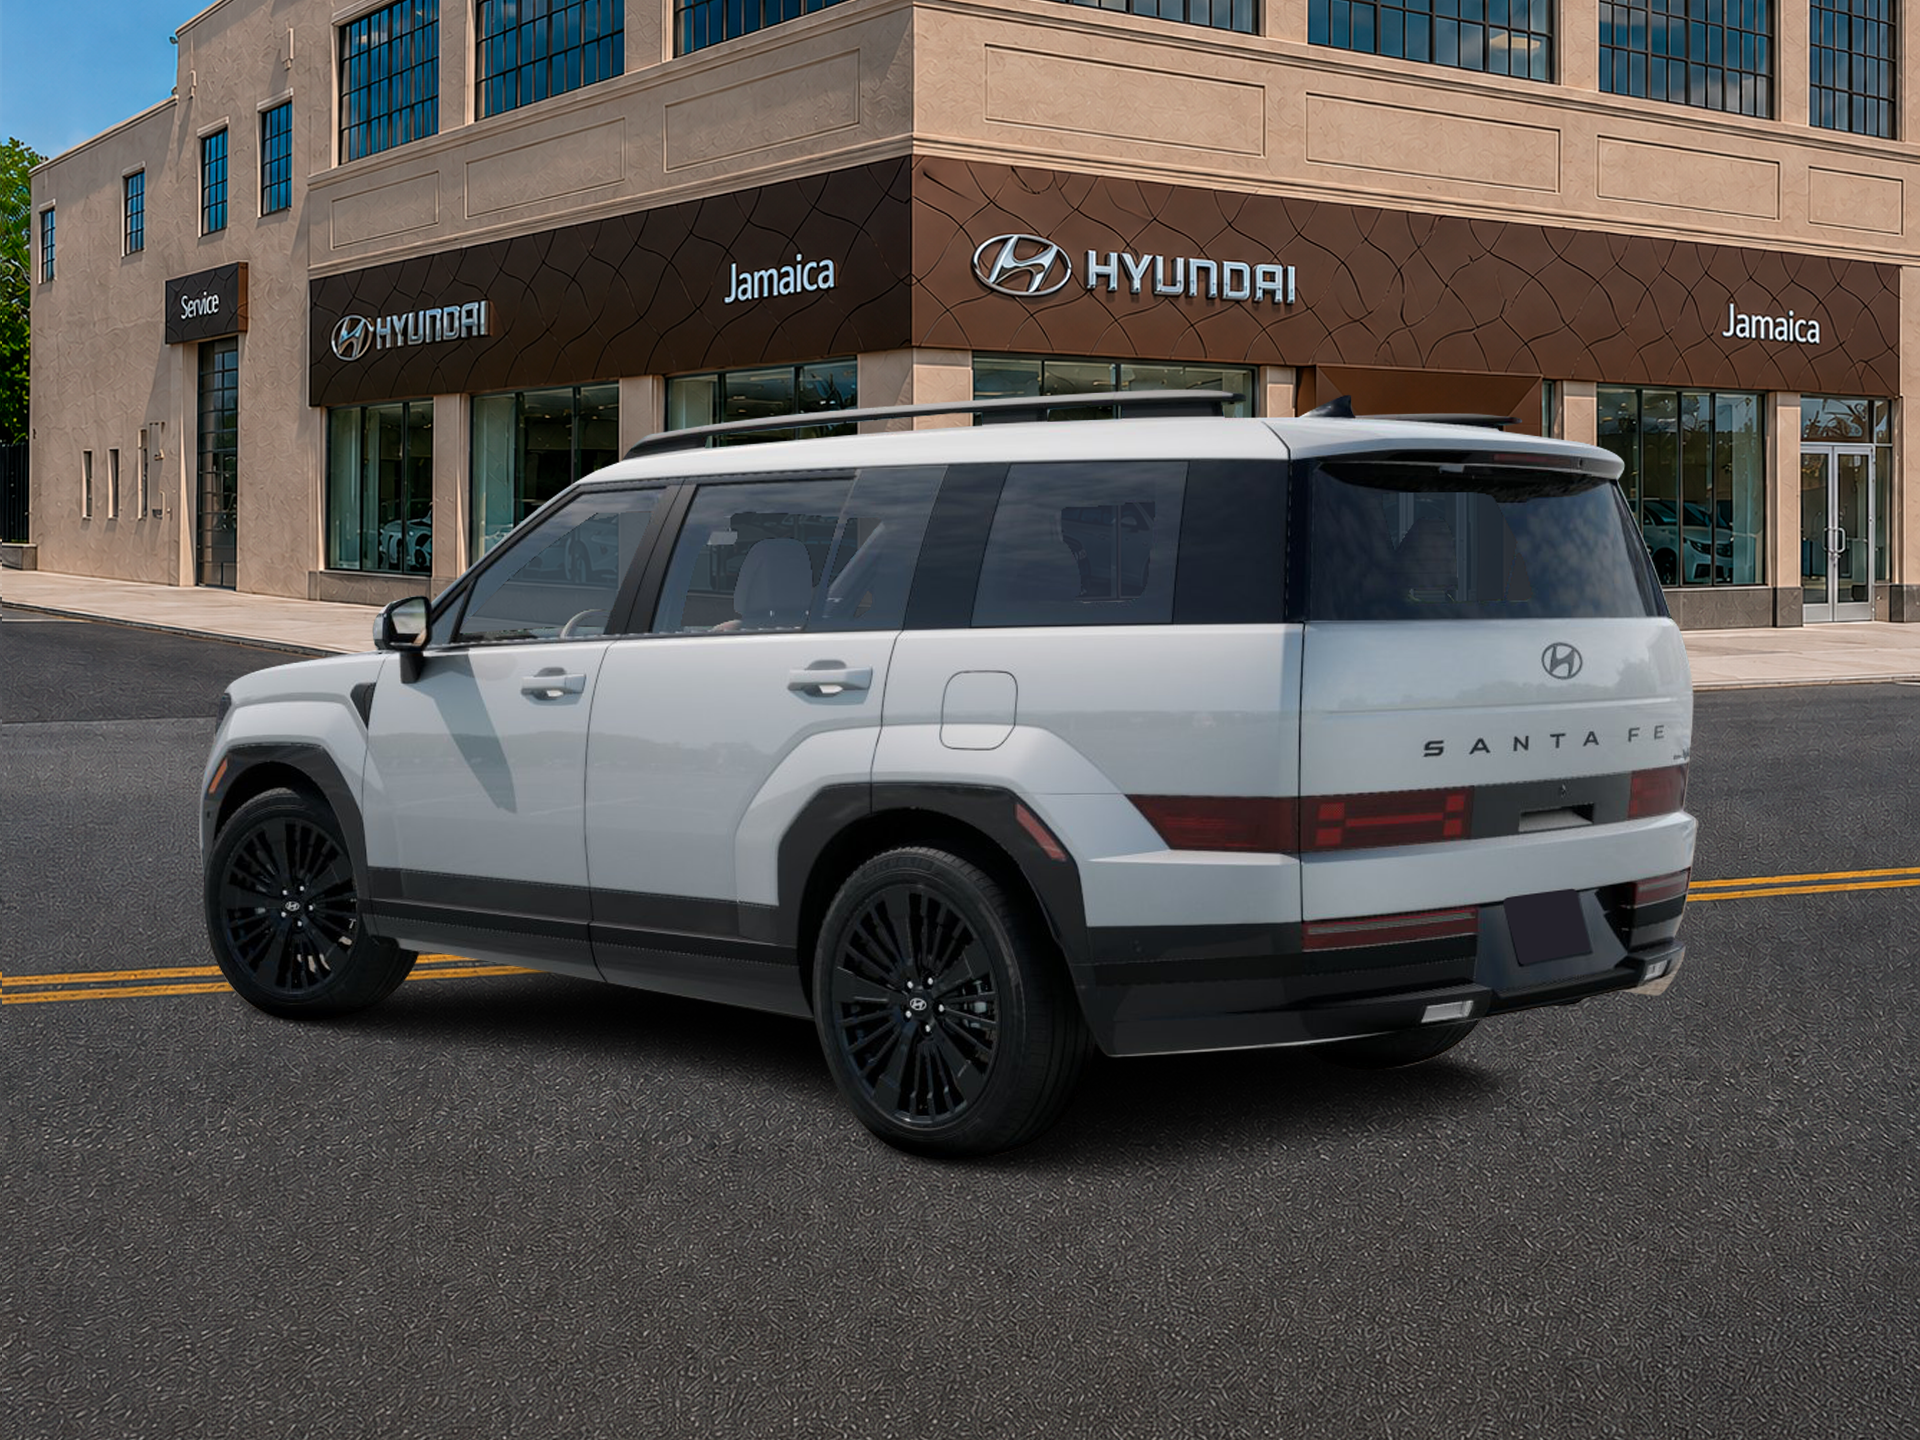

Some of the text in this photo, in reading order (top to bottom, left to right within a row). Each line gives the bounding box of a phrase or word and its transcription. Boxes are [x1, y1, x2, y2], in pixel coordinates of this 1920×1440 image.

[725, 256, 835, 304] Jamaica
[1086, 250, 1296, 304] HYUNDAI
[181, 291, 219, 319] Service
[376, 301, 489, 350] HYUNDAI
[1722, 303, 1821, 344] Jamaica
[1424, 725, 1665, 757] SANTA FE
